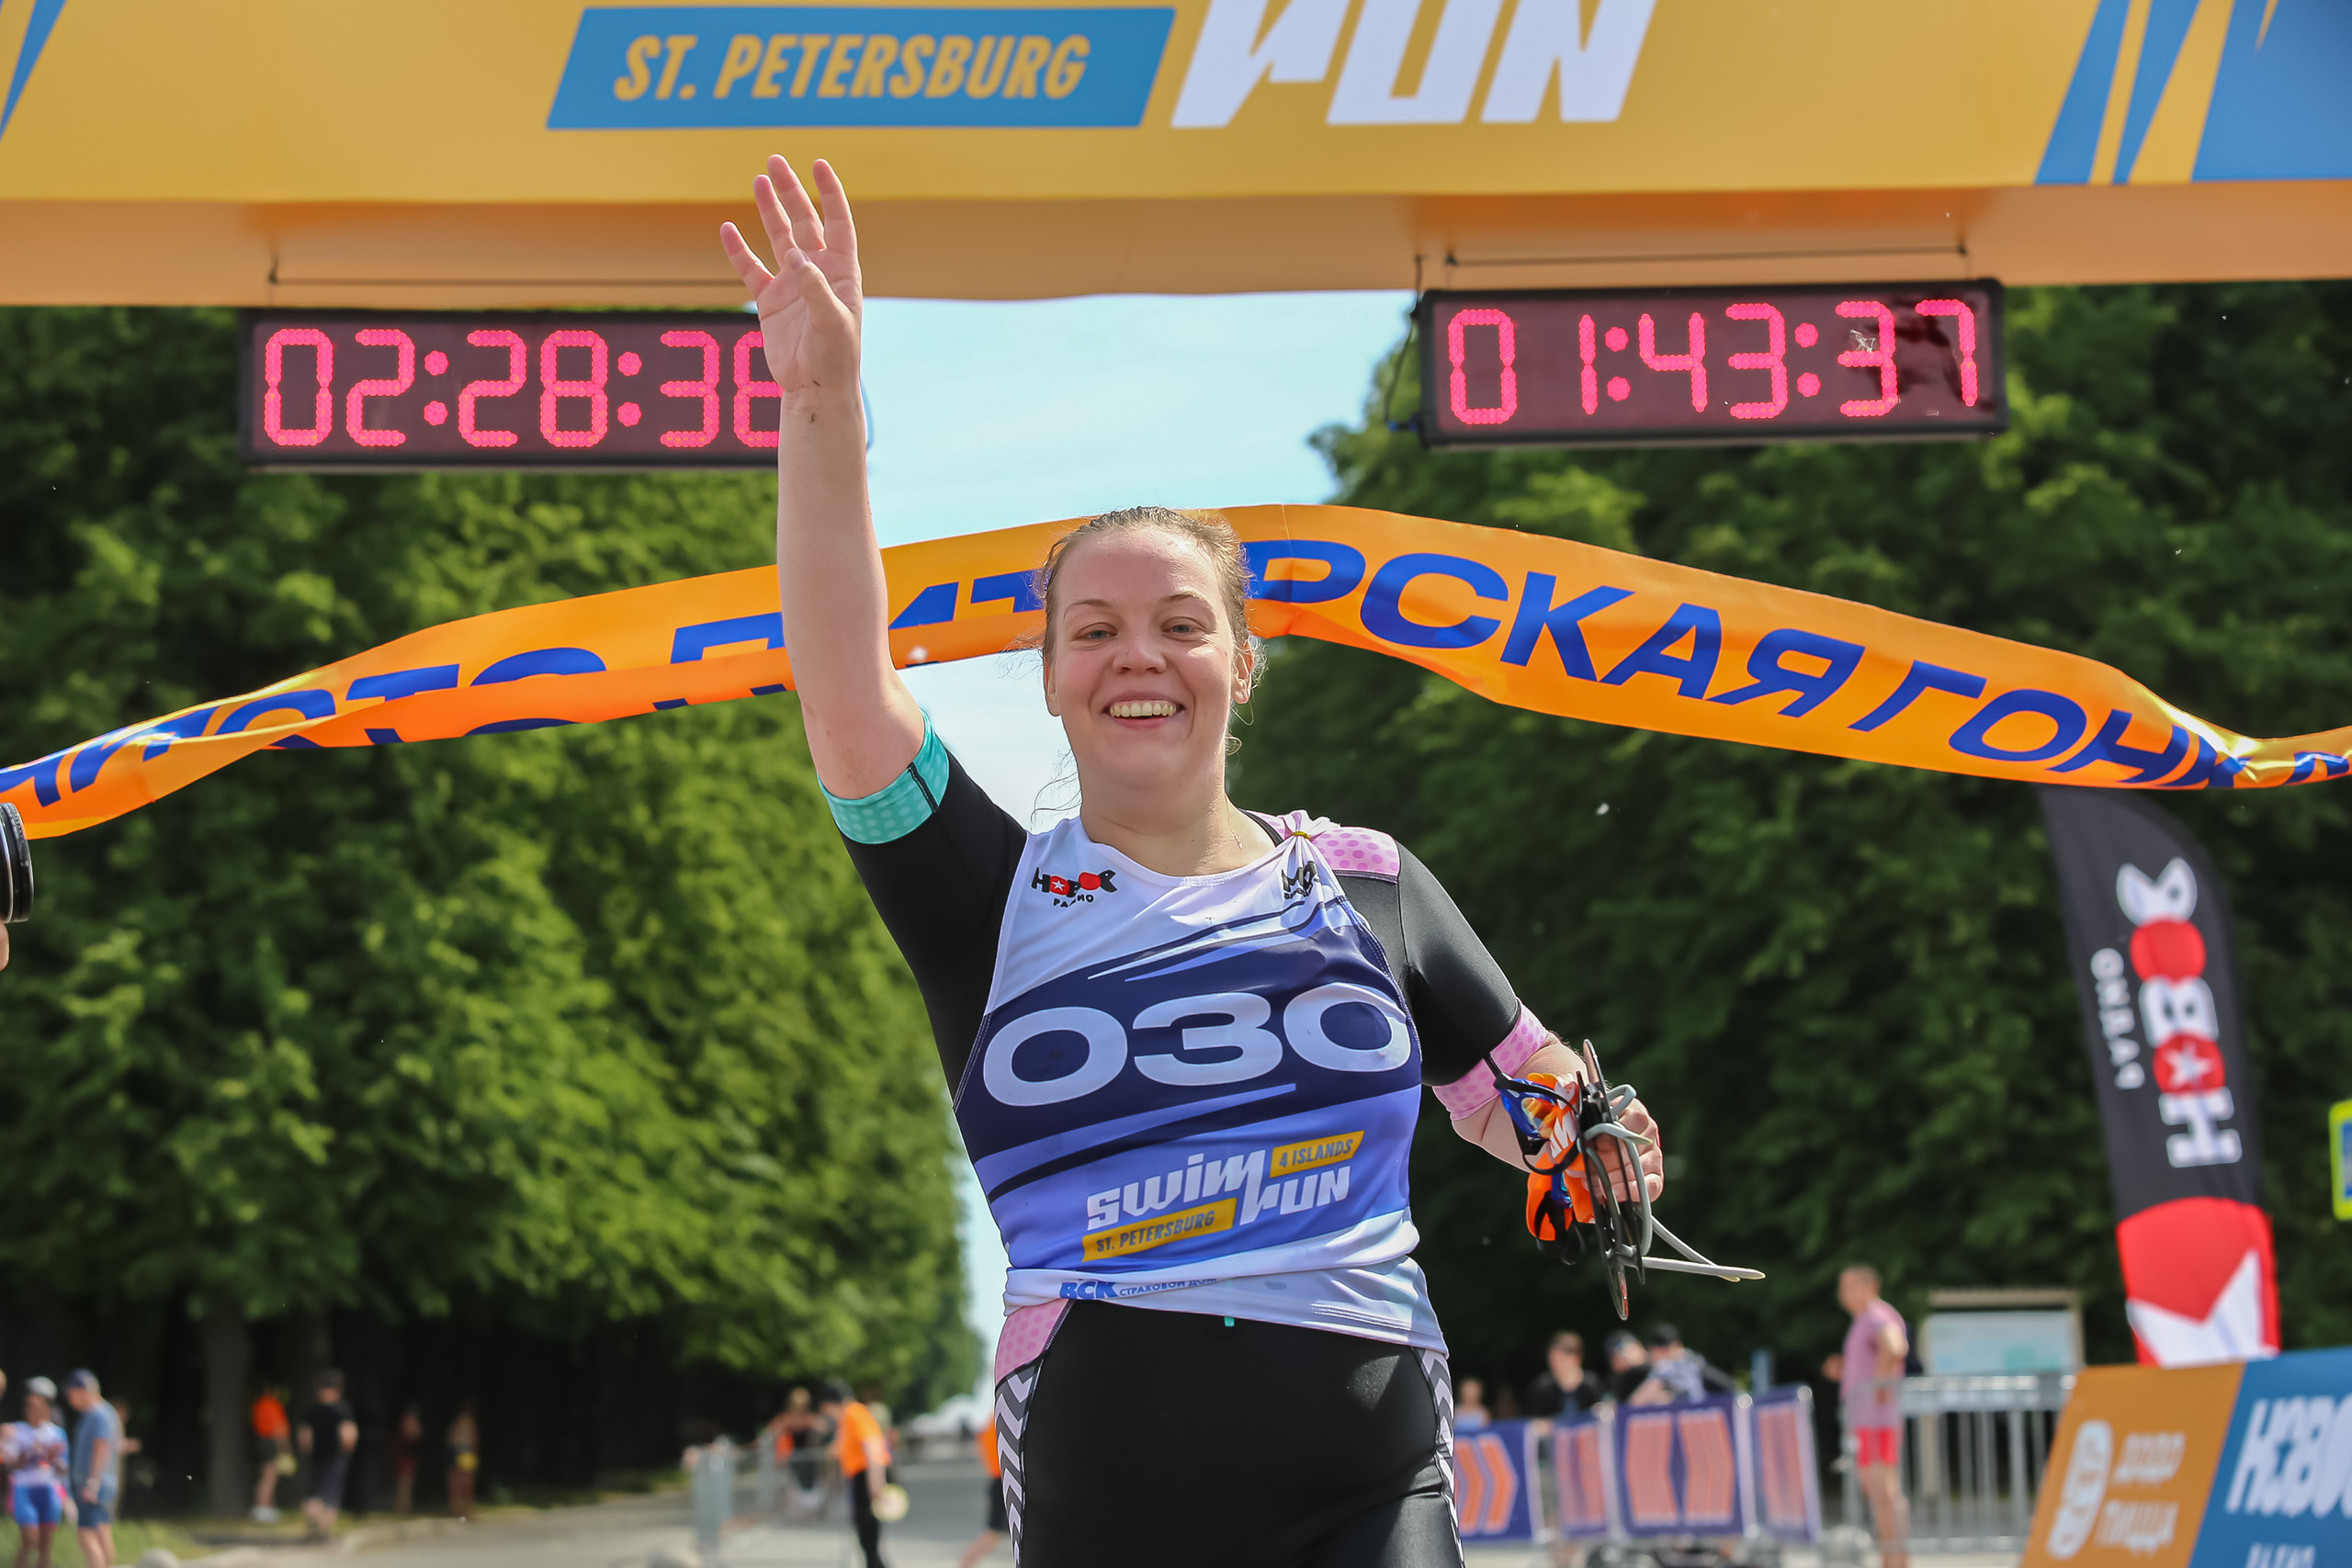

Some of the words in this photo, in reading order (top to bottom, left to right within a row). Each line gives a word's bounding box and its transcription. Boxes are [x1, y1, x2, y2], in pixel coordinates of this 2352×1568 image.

[613, 33, 699, 100] ST.
[712, 33, 1091, 99] PETERSBURG
[1448, 299, 1979, 424] 01:43:37
[983, 981, 1412, 1106] 030
[1279, 1152, 1288, 1168] 4
[1292, 1139, 1355, 1166] ISLANDS
[1096, 1236, 1115, 1253] ST.
[1119, 1210, 1216, 1248] PETERSBURG
[1059, 1280, 1120, 1301] ВСК
